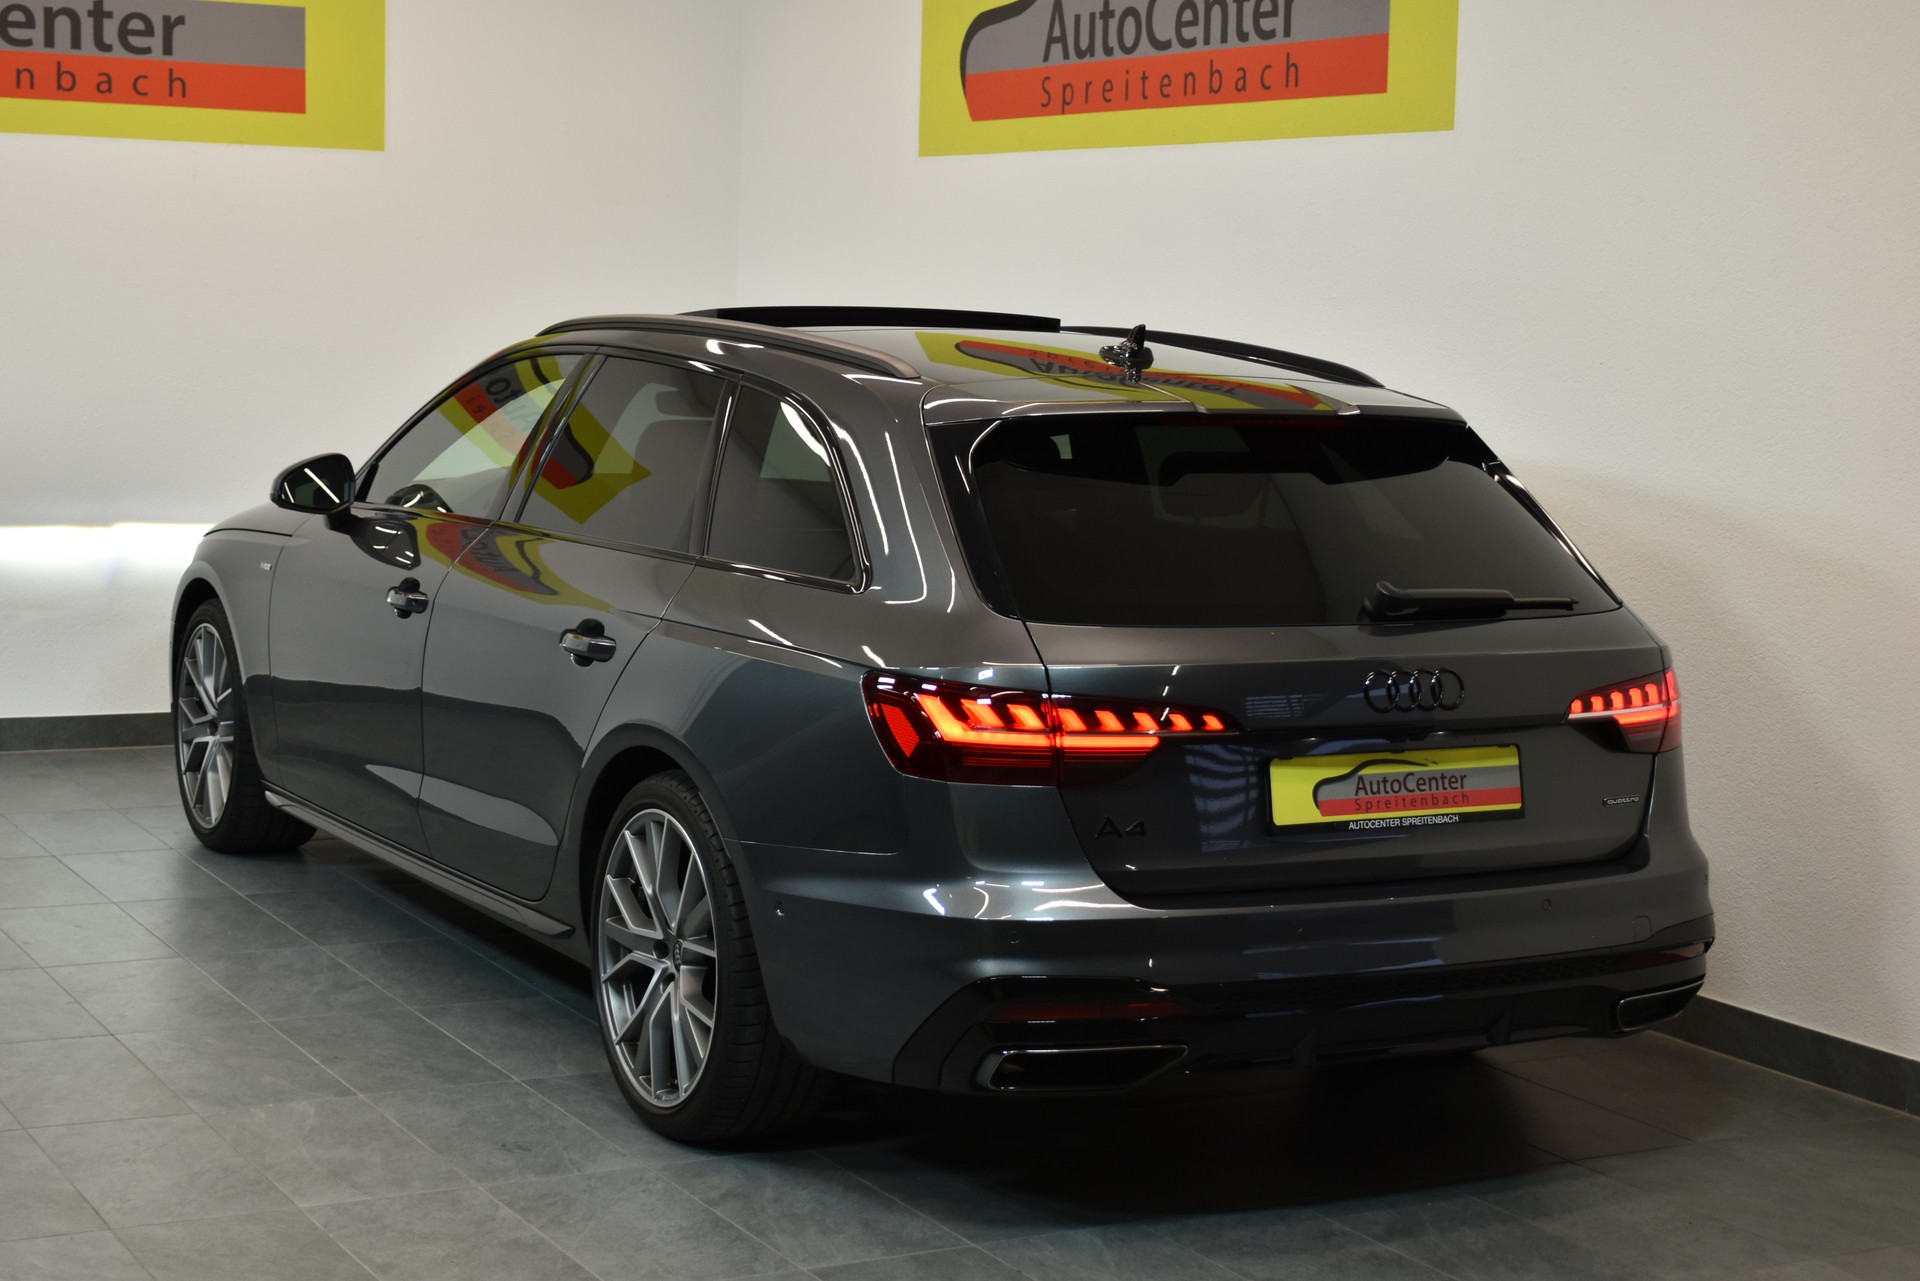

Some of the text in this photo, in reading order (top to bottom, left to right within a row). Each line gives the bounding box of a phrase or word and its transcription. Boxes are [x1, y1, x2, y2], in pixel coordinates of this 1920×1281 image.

[1042, 0, 1295, 63] AutoCenter
[1041, 53, 1300, 114] Spreitenbach
[1355, 772, 1467, 796] AutoCenter
[1355, 792, 1469, 812] Spreitenbach
[1094, 816, 1147, 839] A4
[1349, 814, 1459, 830] AUTOCENTER SPREITENBACH
